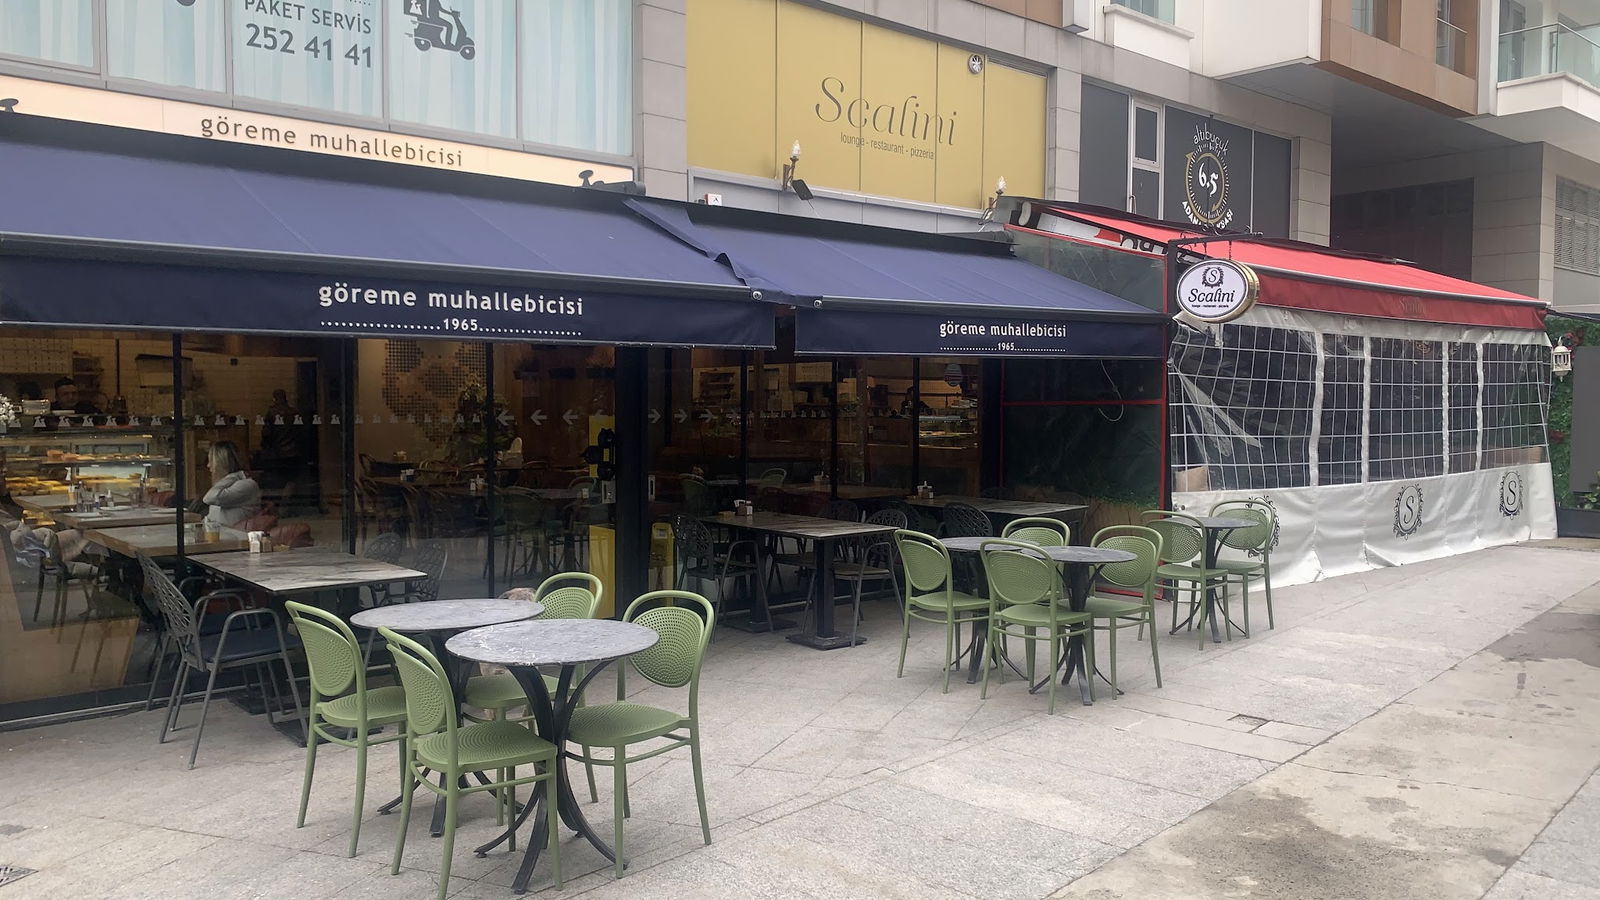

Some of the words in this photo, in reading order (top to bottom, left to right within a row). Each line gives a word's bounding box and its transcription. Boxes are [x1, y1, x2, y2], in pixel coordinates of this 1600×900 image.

[244, 0, 305, 21] PAKET
[311, 8, 372, 34] SERVİS
[246, 23, 295, 55] 252
[304, 36, 332, 61] 41
[344, 43, 371, 68] 41
[815, 76, 957, 146] Scalini
[201, 115, 296, 144] göreme
[310, 133, 462, 167] muhallebicisi
[840, 131, 865, 148] lounge
[870, 138, 904, 155] restaurant
[910, 146, 934, 160] pizzeria
[1208, 269, 1218, 283] S
[319, 282, 417, 308] göreme
[428, 289, 583, 316] muhallebicisi
[1188, 287, 1236, 303] Scalini
[940, 320, 986, 338] göreme
[990, 322, 1067, 338] muhallebicisi
